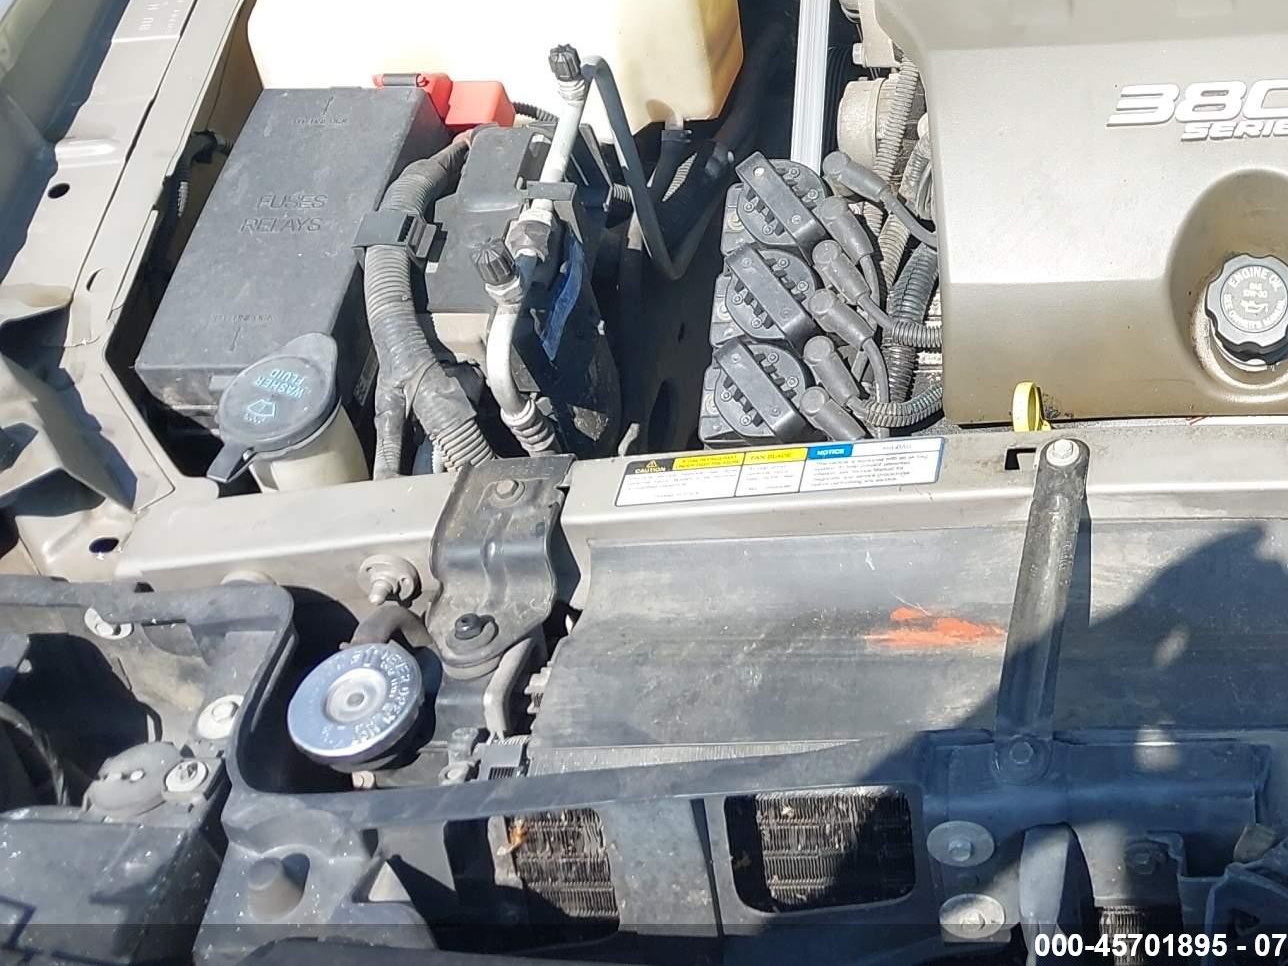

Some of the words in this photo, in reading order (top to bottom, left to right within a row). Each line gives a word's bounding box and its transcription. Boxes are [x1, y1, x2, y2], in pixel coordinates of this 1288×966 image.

[257, 194, 328, 209] FUSES
[239, 217, 323, 233] RELAYS
[1227, 265, 1269, 288] ENGINE
[270, 368, 305, 386] FLUID
[255, 376, 306, 399] WASHER
[816, 448, 846, 456] NOTICE
